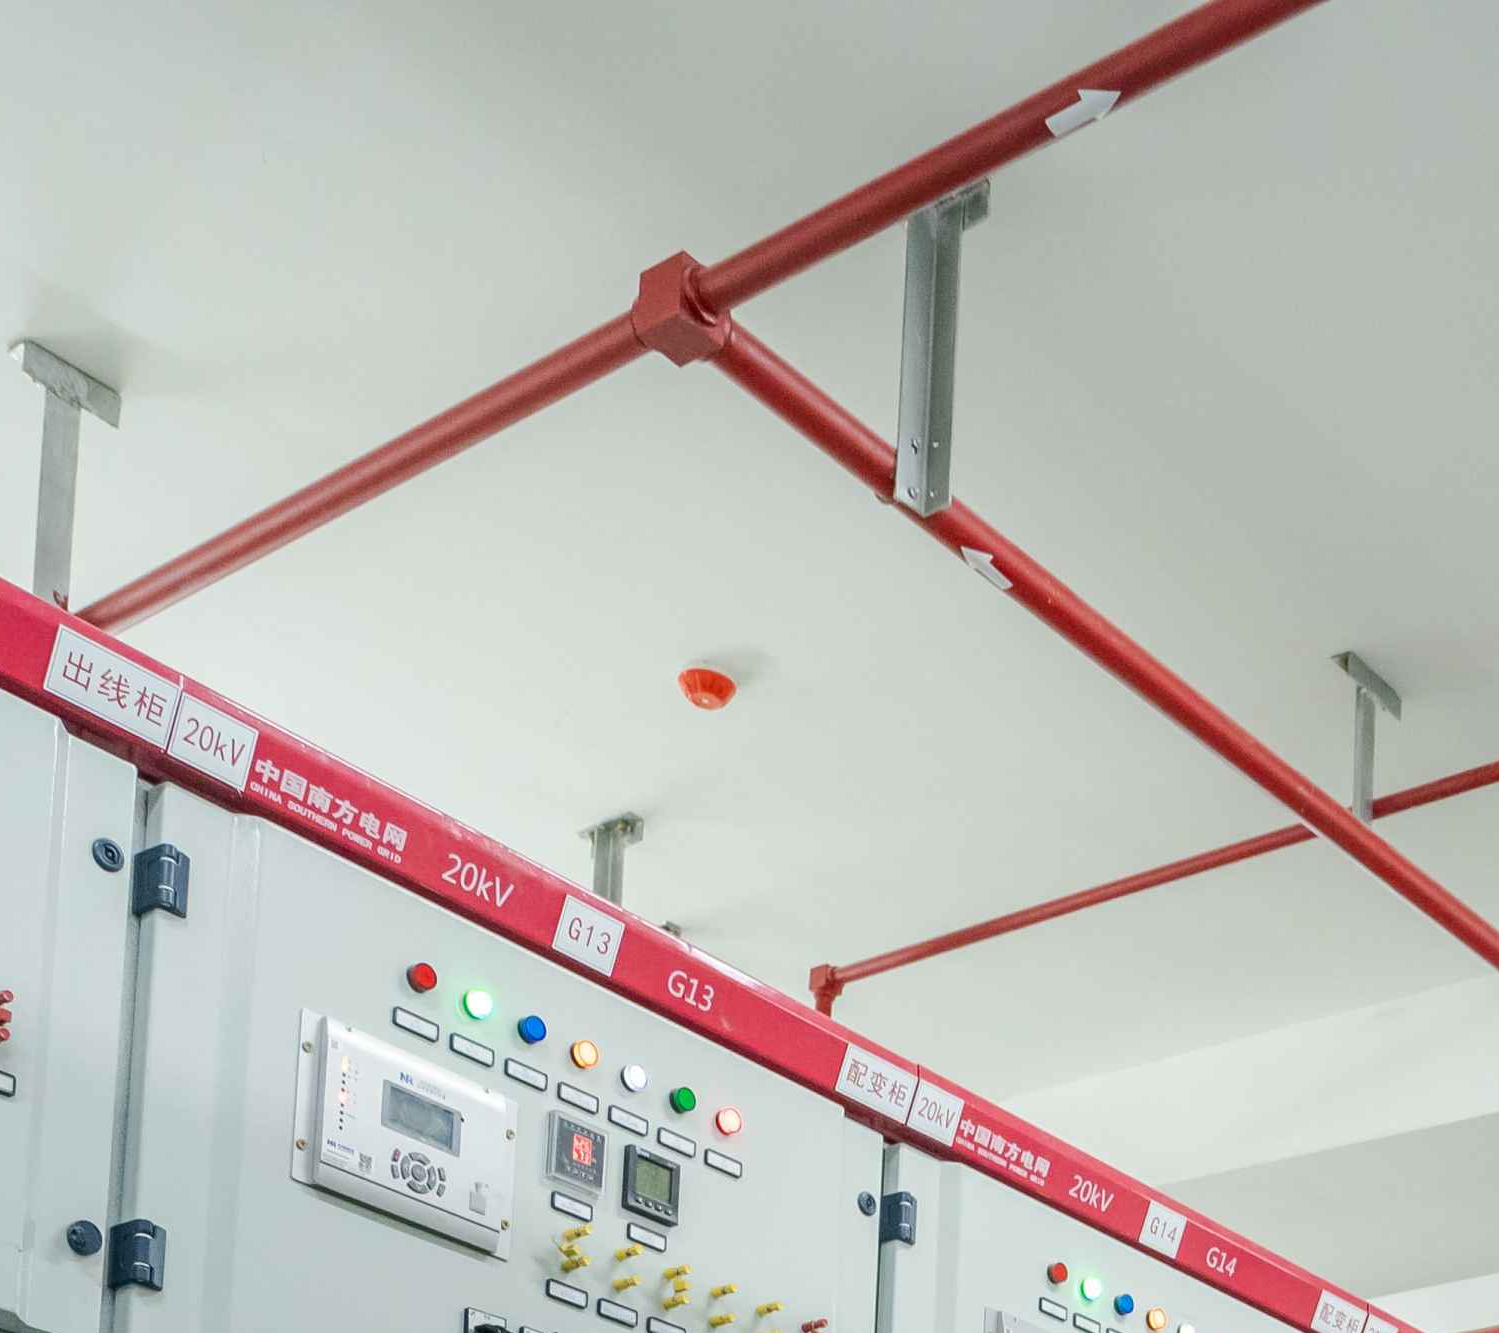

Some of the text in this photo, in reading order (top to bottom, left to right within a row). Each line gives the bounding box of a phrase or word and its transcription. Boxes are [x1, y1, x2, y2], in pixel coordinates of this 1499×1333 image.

[62, 651, 168, 728] 出线柜
[183, 717, 246, 768] 20kV
[255, 758, 408, 852] 中国南方电网
[441, 853, 515, 908] 20kV
[568, 917, 612, 955] G13
[666, 969, 715, 1012] G13
[846, 1058, 909, 1110] 配变柜
[917, 1096, 957, 1129] 20kV
[960, 1118, 1051, 1178] 中国南方电网
[1068, 1174, 1115, 1213] 20kV
[1150, 1215, 1178, 1245] G14
[1205, 1246, 1239, 1279] G14
